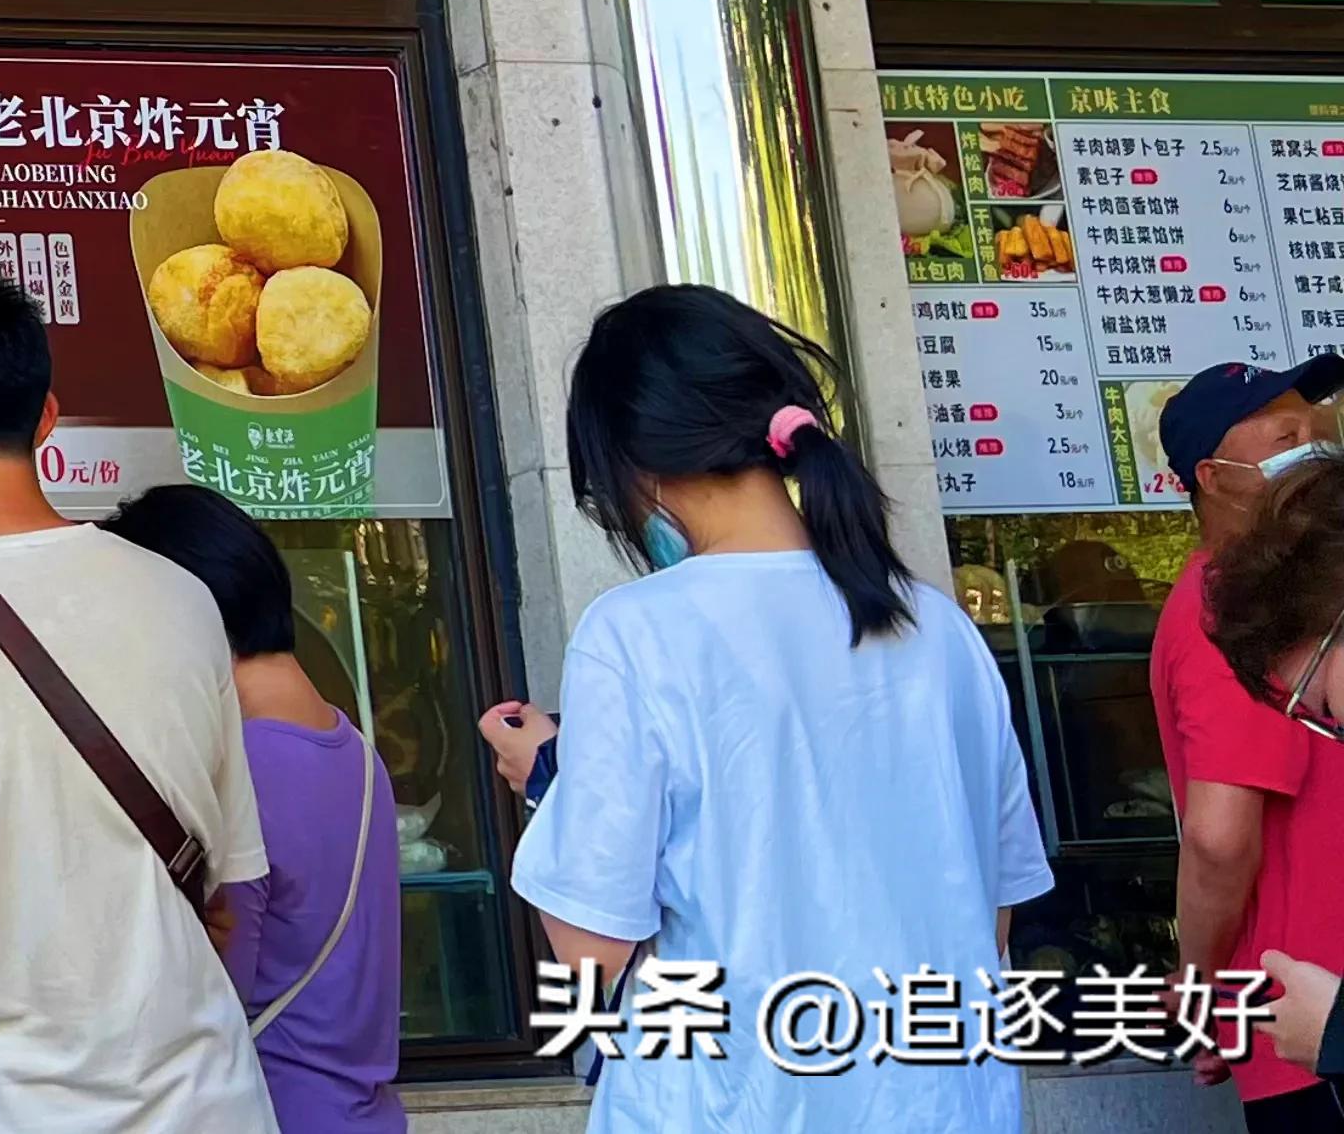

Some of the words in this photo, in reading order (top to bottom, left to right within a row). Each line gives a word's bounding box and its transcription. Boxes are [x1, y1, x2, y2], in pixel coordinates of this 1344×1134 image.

[1067, 85, 1172, 115] 京味主食
[1072, 137, 1185, 156] 羊肉胡萝卜包子
[1270, 139, 1319, 158] 菜窝头
[1077, 166, 1125, 185] 素包子
[1082, 196, 1180, 216] 牛肉茴香馅饼
[1087, 226, 1185, 245] 牛肉韭菜馅饼
[1092, 255, 1156, 275] 牛肉烧饼
[54, 240, 75, 317] 色泽金黄
[912, 301, 968, 321] 鸡肉粒
[1101, 315, 1167, 334] 椒盐烧饼
[916, 335, 956, 355] 豆腐
[1107, 345, 1172, 364] 豆馅烧饼
[921, 369, 961, 390] 卷果
[928, 403, 966, 423] 油香
[1105, 386, 1136, 502] 牛肉大葱包子
[178, 441, 375, 503] 老北京炸元宵
[936, 473, 976, 493] 丸子
